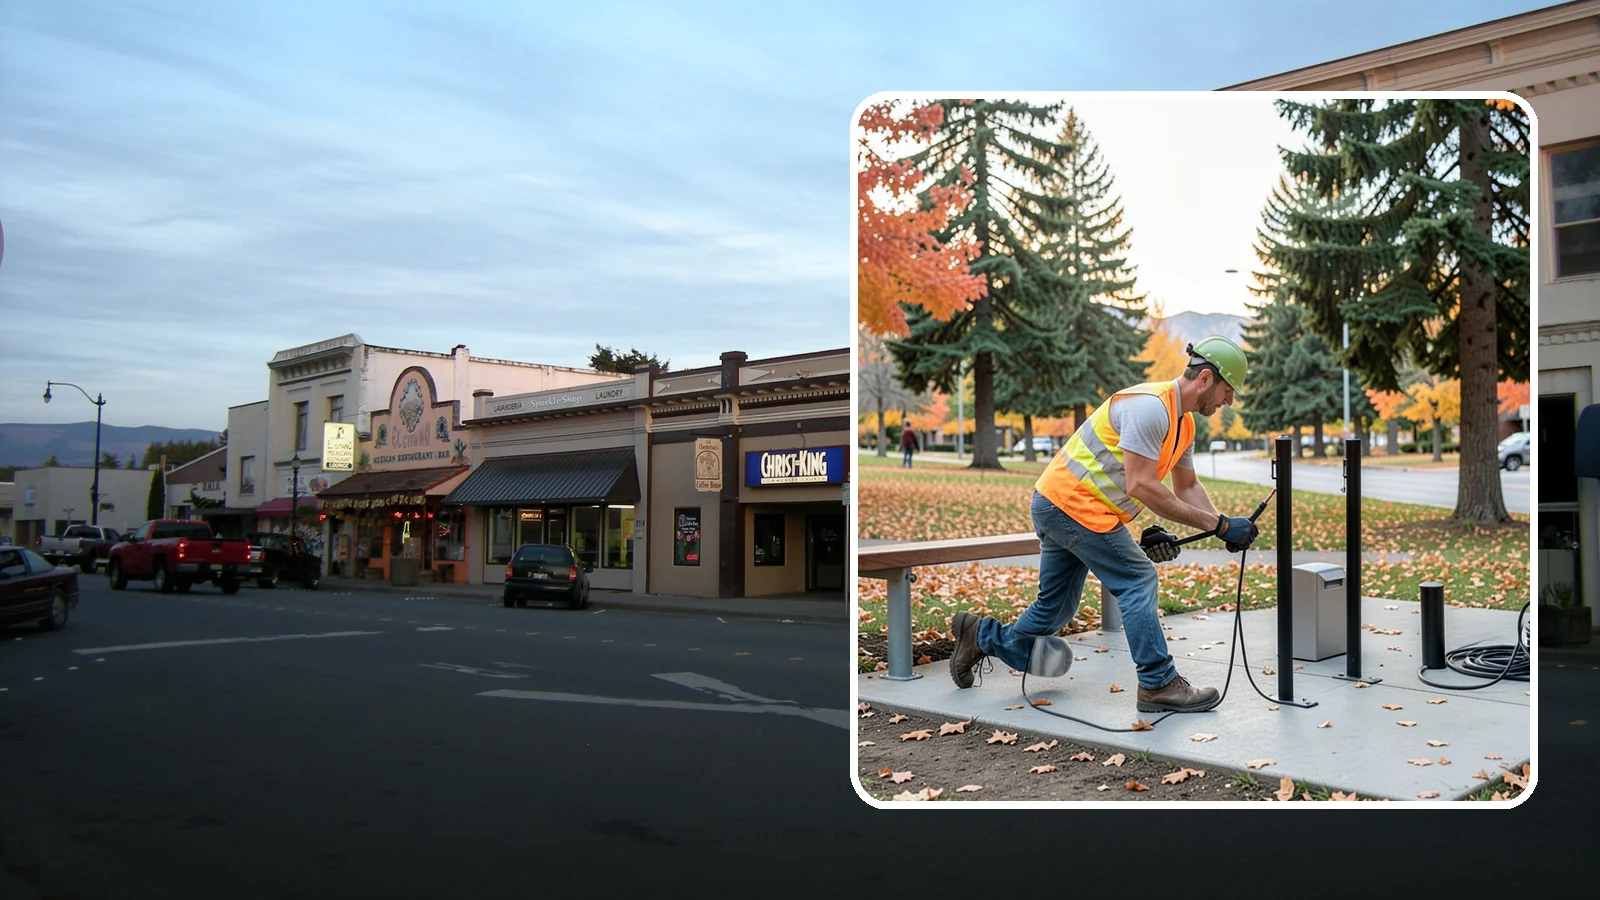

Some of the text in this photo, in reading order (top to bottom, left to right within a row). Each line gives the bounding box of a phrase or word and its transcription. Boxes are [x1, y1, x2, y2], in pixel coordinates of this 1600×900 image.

[493, 388, 624, 413] LAVANDERIA Sparkle Shop LAUNDRY
[391, 426, 401, 449] EL
[373, 454, 397, 464] MEXICAN
[397, 451, 434, 462] RESTAURANT
[438, 450, 450, 459] BAR
[761, 452, 797, 478] CHRIST
[799, 450, 827, 476] KING
[696, 480, 722, 488] Coffee House
